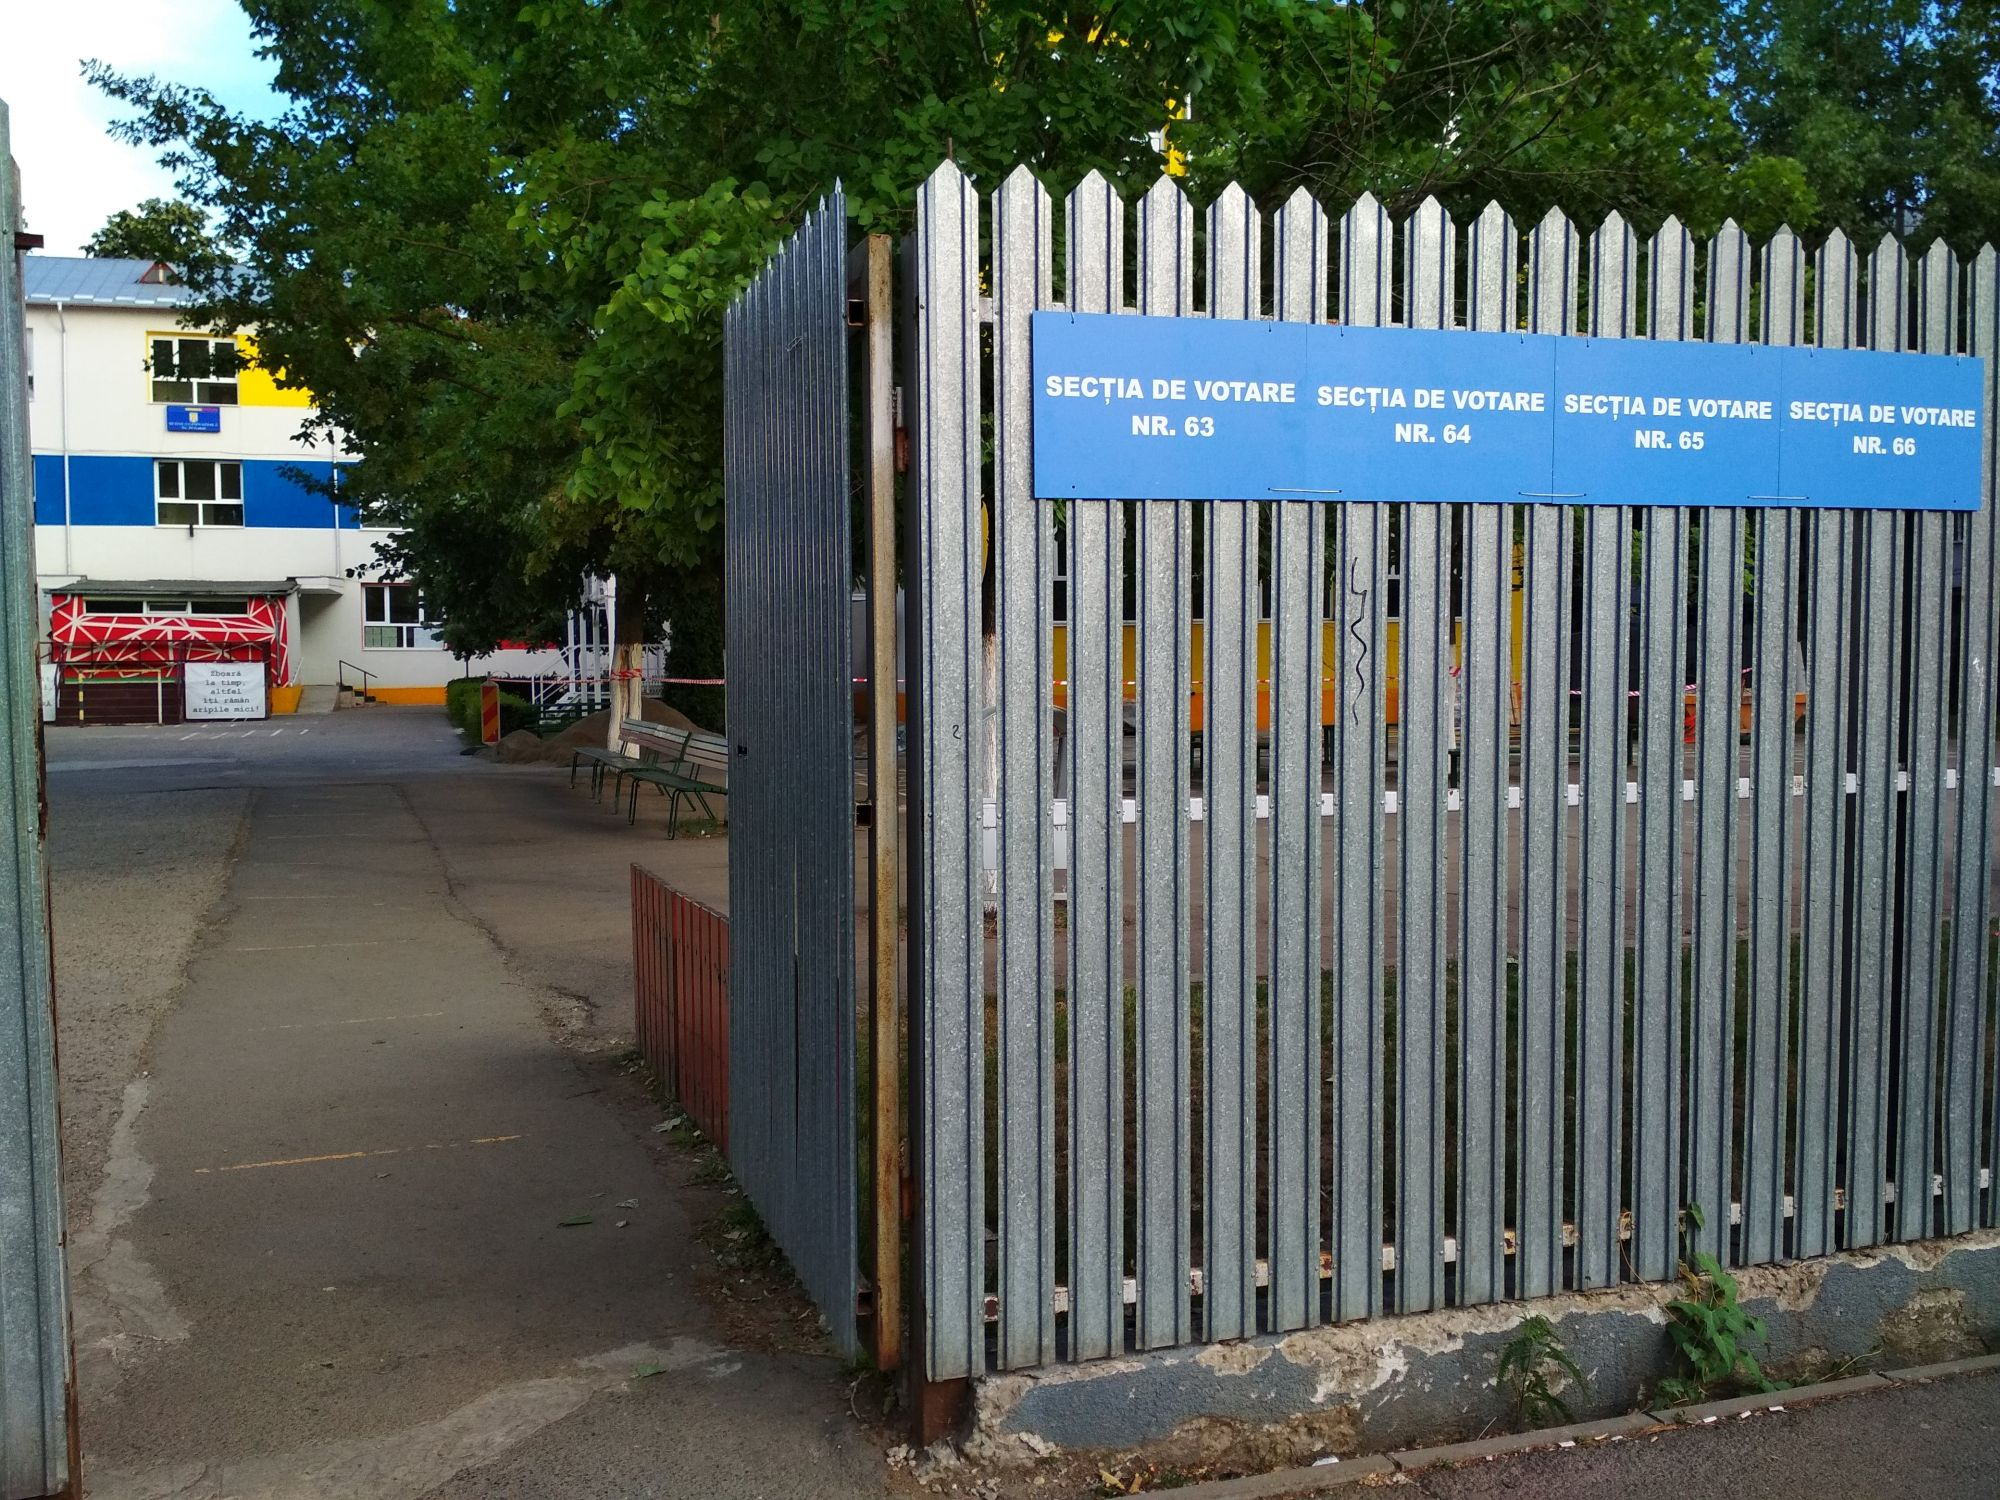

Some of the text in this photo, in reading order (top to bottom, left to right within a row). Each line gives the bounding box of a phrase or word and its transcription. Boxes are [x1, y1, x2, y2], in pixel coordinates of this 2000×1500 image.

[1045, 375, 1296, 406] SECȚIA DE VOTARE
[1317, 385, 1545, 414] SECȚIA DE VOTARE
[1564, 393, 1772, 421] SECȚIA DE VOTARE
[1789, 400, 1976, 428] SECȚIA DE VOTARE
[1131, 414, 1215, 438] NR. 63
[1394, 422, 1472, 444] NR. 64
[1635, 429, 1705, 450] NR. 65
[1853, 435, 1916, 456] NR. 66
[192, 705, 260, 714] aripile mici!
